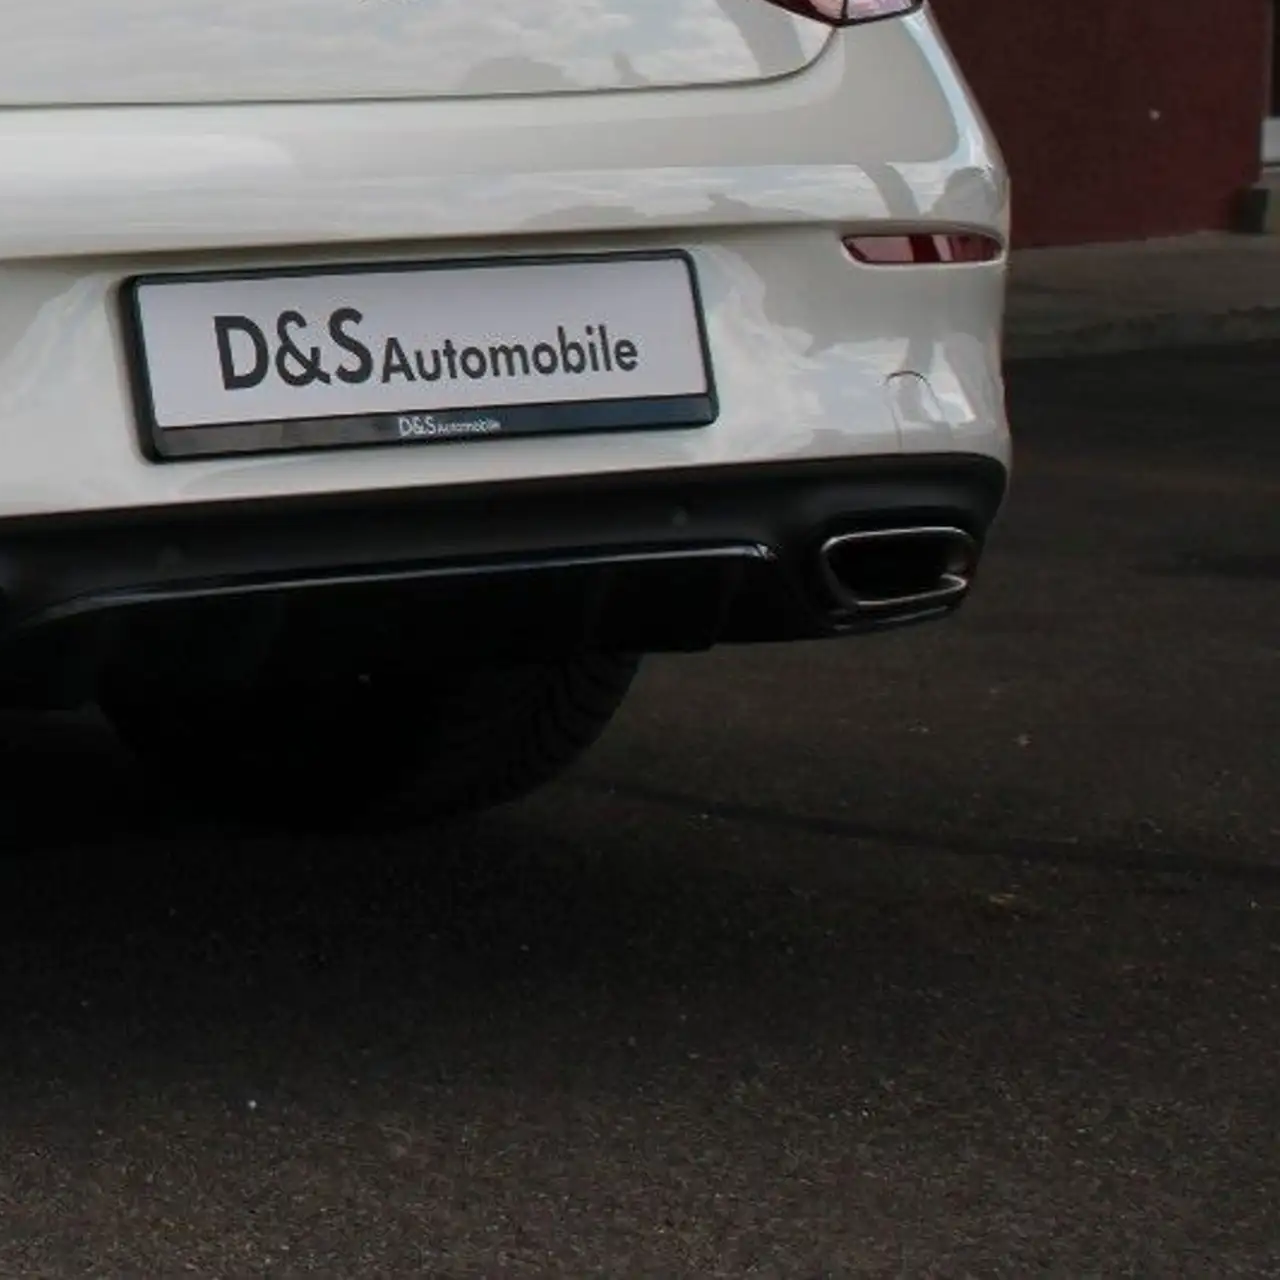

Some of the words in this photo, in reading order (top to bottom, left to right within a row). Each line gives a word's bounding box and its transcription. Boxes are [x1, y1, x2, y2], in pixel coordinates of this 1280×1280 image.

[214, 307, 373, 391] D&S
[381, 324, 639, 385] Automobile
[398, 415, 437, 437] D&S
